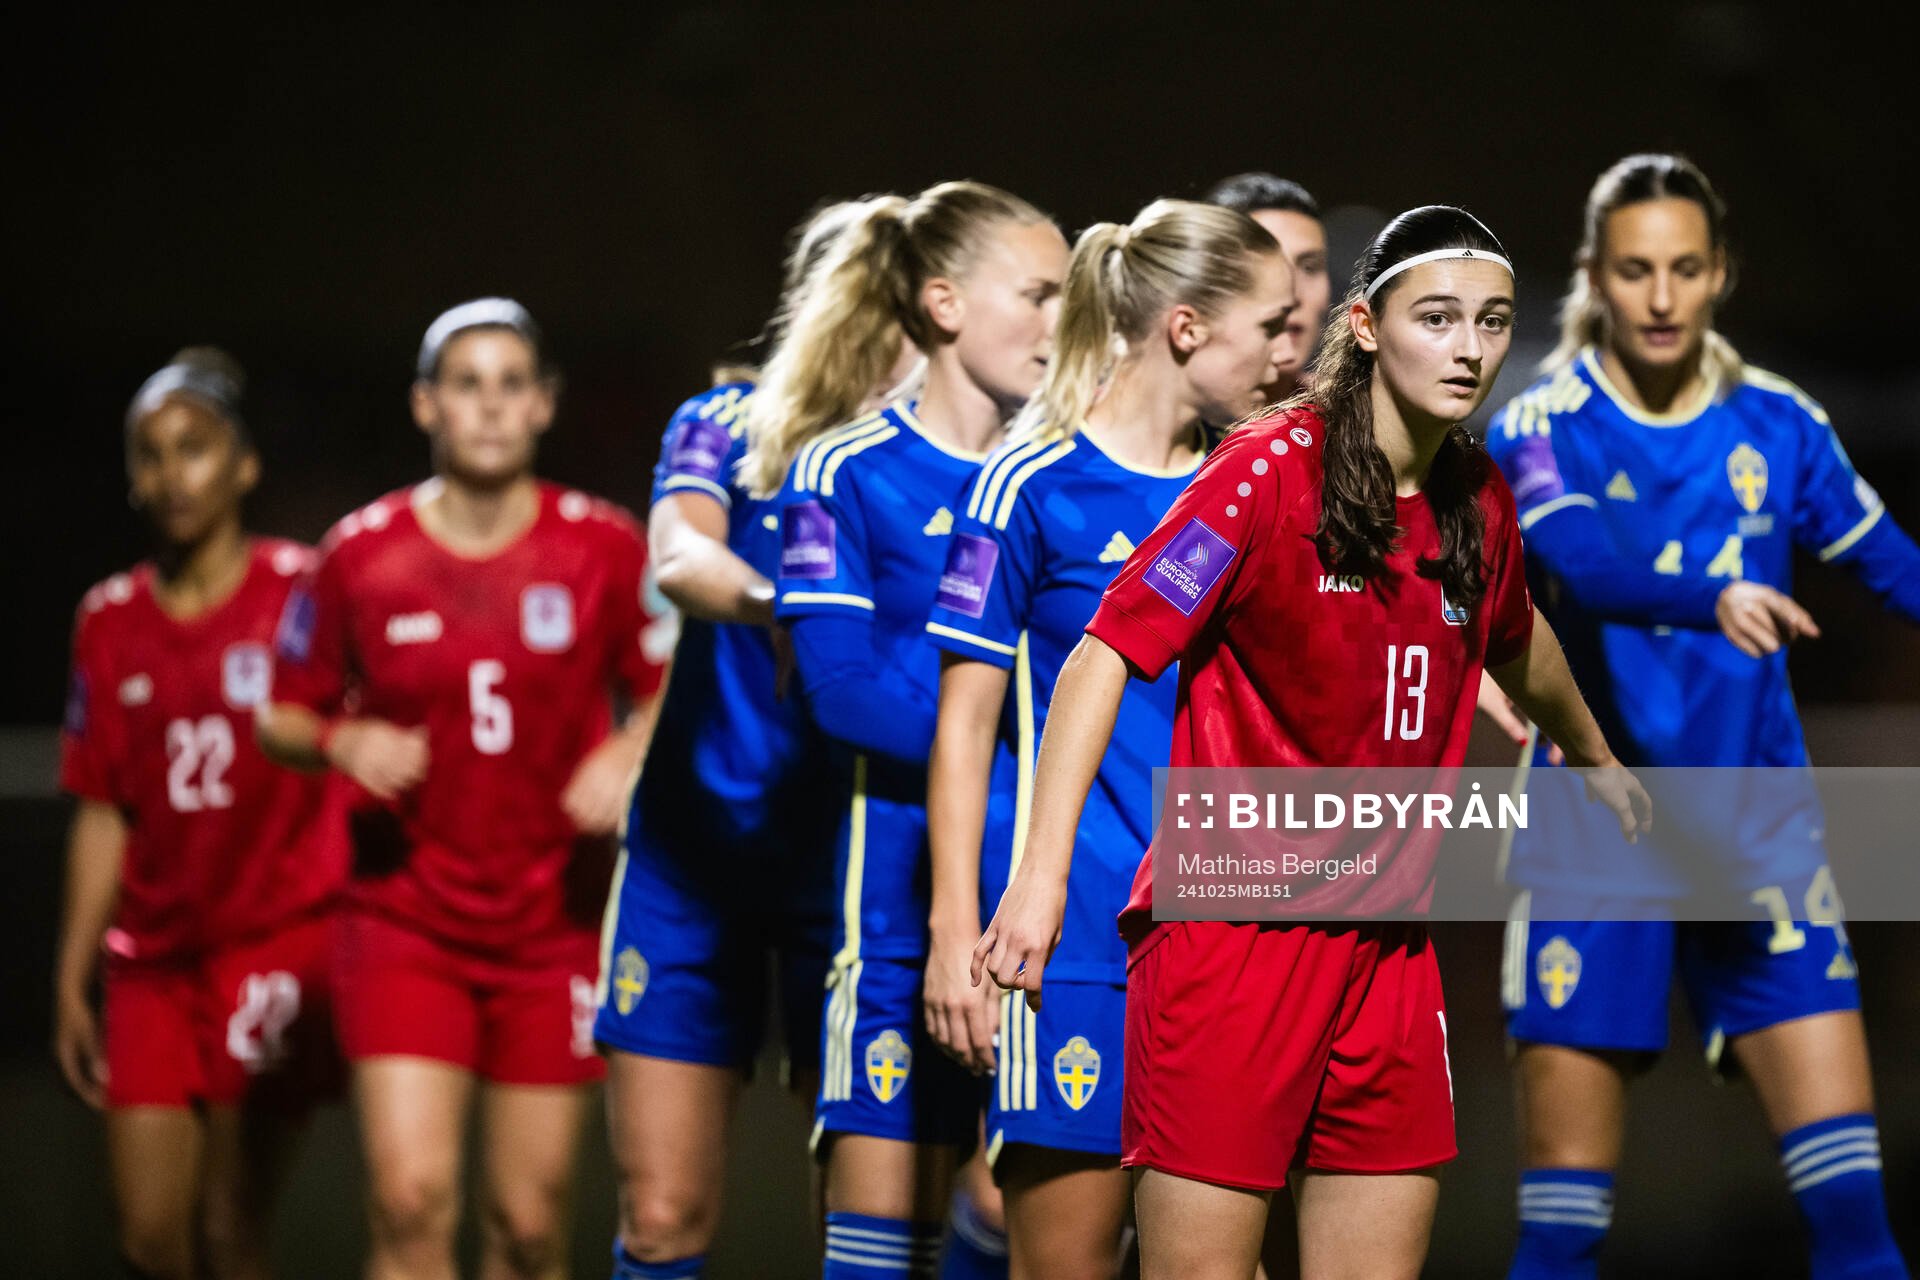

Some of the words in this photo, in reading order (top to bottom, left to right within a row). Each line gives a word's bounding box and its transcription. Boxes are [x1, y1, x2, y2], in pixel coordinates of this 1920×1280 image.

[1155, 563, 1199, 600] QUALIFIERS
[1160, 557, 1203, 593] EUROPEAN
[1317, 575, 1365, 593] JAKO
[468, 659, 514, 755] 5
[1384, 644, 1429, 741] 13
[165, 713, 236, 813] 22
[1751, 865, 1848, 954] 14
